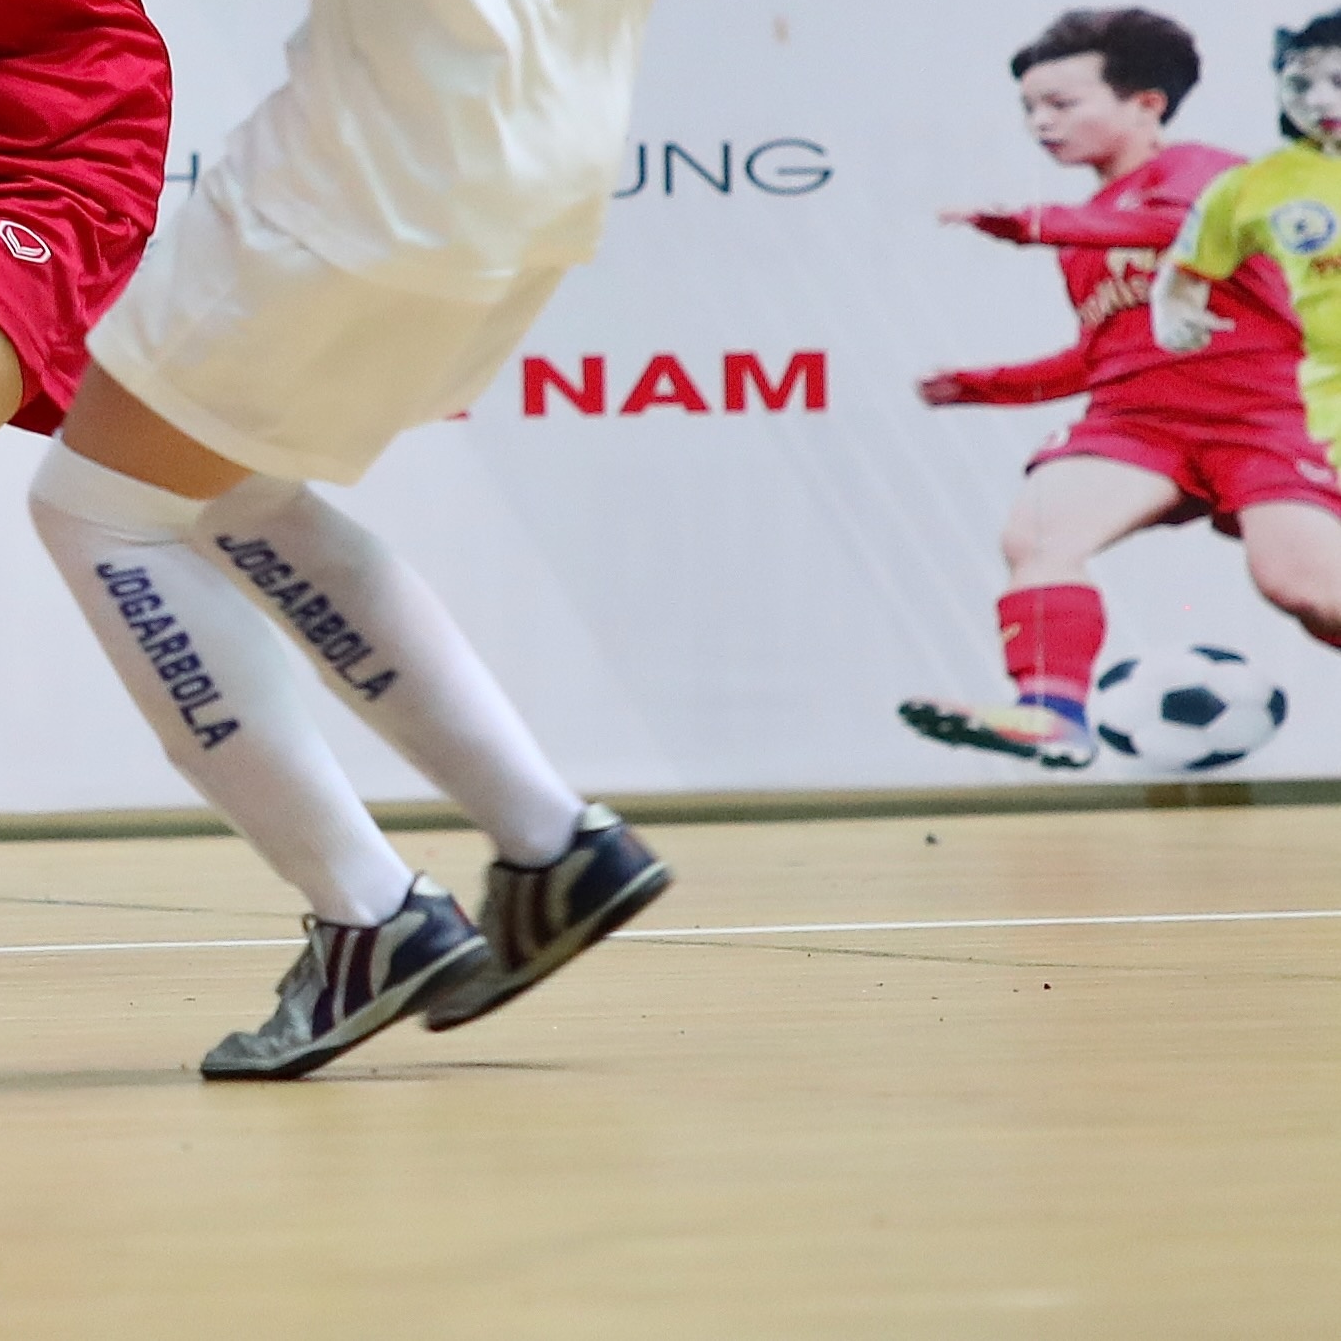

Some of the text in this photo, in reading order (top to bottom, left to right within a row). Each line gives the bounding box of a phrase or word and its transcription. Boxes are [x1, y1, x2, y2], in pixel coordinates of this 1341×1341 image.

[521, 349, 829, 420] NAM
[96, 561, 243, 753] JOGARBOLA
[216, 531, 402, 704] JOGARBOLA
